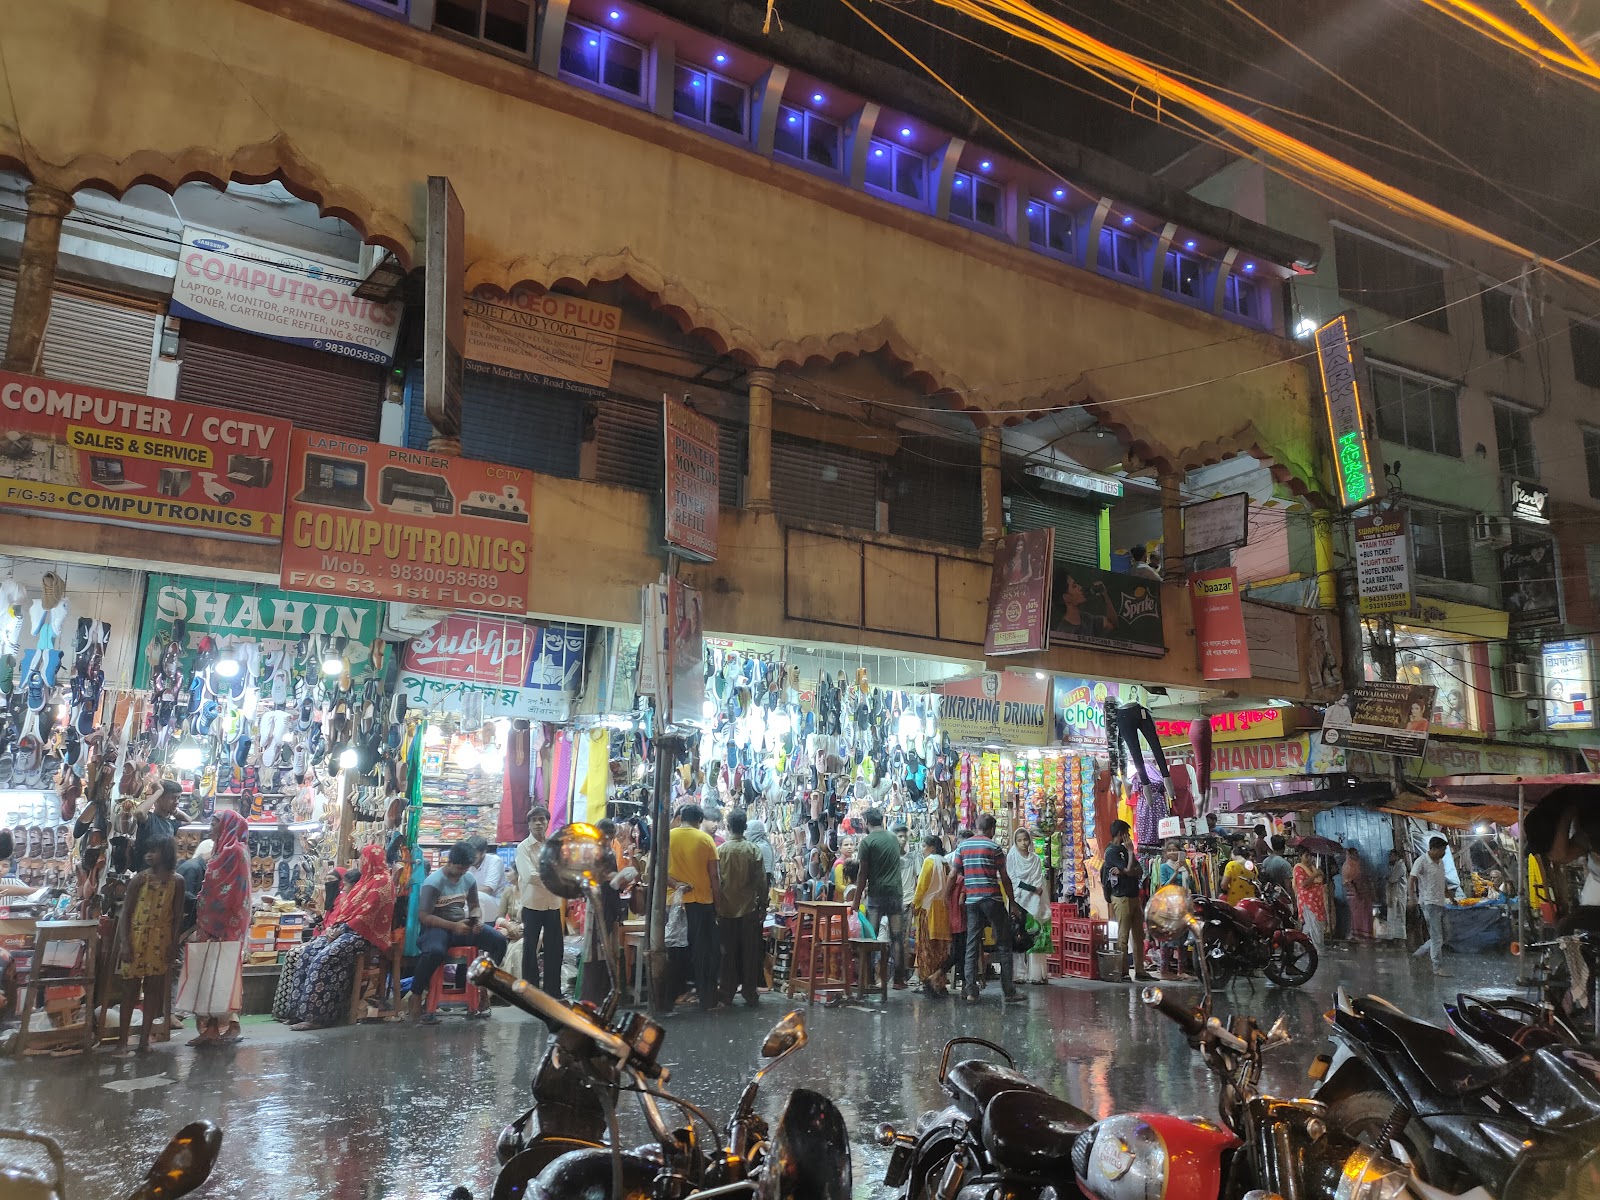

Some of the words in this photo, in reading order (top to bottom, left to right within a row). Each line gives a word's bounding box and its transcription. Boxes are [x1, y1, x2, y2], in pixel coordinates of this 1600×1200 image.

[197, 239, 225, 250] SAMSUNG
[185, 253, 397, 327] COMPUTRONICS
[180, 279, 223, 298] LAPTOP,
[227, 291, 279, 314] MONITOR,
[331, 318, 350, 330] UPS
[352, 323, 392, 340] SERVICE
[190, 293, 227, 311] TONER,
[230, 303, 289, 326] CARTRIDGE
[292, 319, 343, 339] REFILLING
[346, 332, 354, 341] &
[355, 335, 381, 347] CCTV
[475, 304, 507, 319] DIET
[509, 313, 538, 328] AND
[541, 320, 578, 337] YOGA
[564, 302, 616, 331] PLUS
[325, 341, 387, 365] 9830058589
[466, 360, 489, 374] Super
[492, 365, 522, 380] Market
[523, 373, 541, 384] N.S.
[543, 377, 564, 389] Road
[566, 382, 607, 398] Serampore
[2, 383, 172, 435] COMPUTER
[181, 412, 194, 437] /
[201, 417, 275, 450] CCTV
[73, 430, 125, 453] SALES
[128, 440, 140, 453] &
[143, 441, 208, 463] SERVICE
[308, 436, 369, 455] LAPTOP
[675, 436, 715, 468] PRINTER
[388, 450, 450, 470] PRINTER
[675, 454, 718, 487] MONITOR
[486, 466, 522, 481] CCTV
[7, 487, 56, 503] F/G-53
[67, 491, 252, 528] COMPUTRONICS
[675, 490, 706, 516] TONER
[675, 508, 706, 534] REFILL
[1358, 523, 1400, 536] SWAPNODEEP
[293, 510, 526, 574] COMPUTRONICS
[1363, 541, 1377, 549] TRAIN
[1378, 539, 1396, 547] TICKET
[1374, 548, 1391, 556] TICKET
[1364, 558, 1380, 567] FLIGHT
[1382, 556, 1400, 564] TICKET
[1365, 568, 1380, 576] HOTEL
[1381, 565, 1404, 574] BOOKING
[390, 563, 499, 590] 9830058589
[1204, 582, 1232, 593] baazar
[1366, 585, 1388, 594] PACKAGE
[1389, 583, 1403, 591] TOUR
[1377, 575, 1395, 583] RENTAL
[289, 572, 337, 590] F/G
[345, 578, 383, 597] 53,
[392, 583, 430, 600] 1st
[437, 588, 524, 609] FLOOR
[156, 586, 370, 639] SHAHIN
[1123, 595, 1155, 621] Sprite
[411, 627, 524, 665] Subha
[1354, 689, 1409, 701] PRIYADARSHINI
[1004, 702, 1044, 729] DRINKS
[1065, 706, 1107, 729] choic
[1068, 736, 1083, 744] Shop
